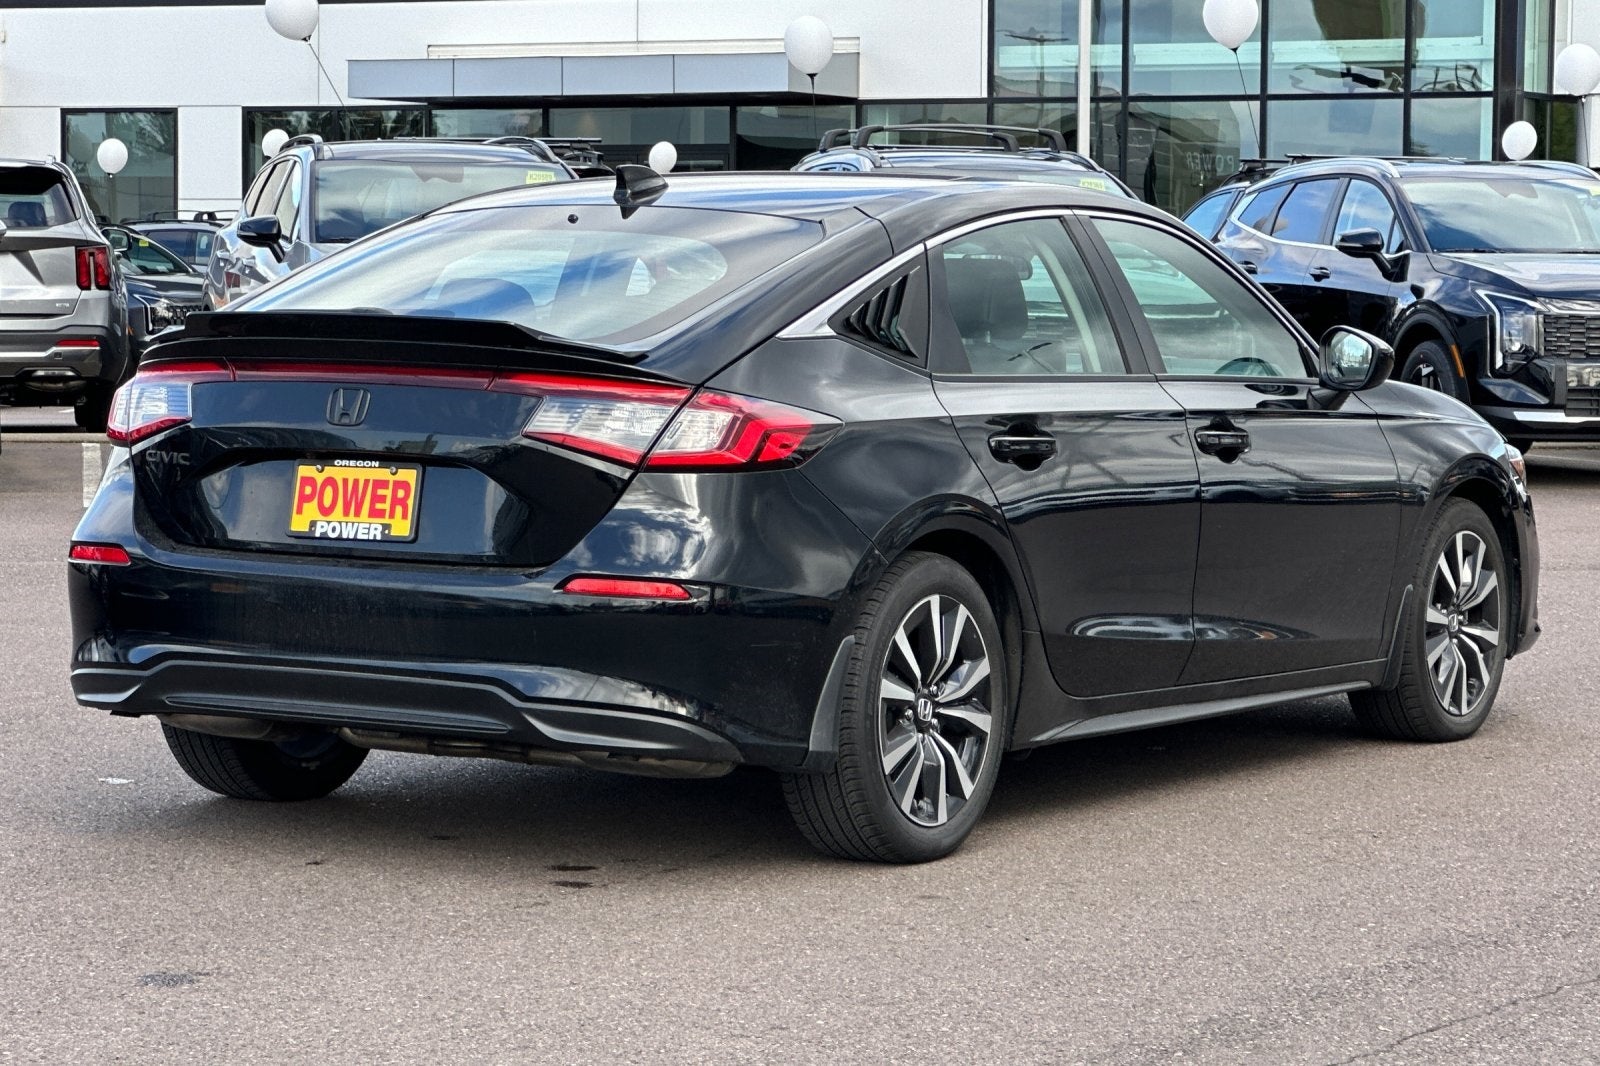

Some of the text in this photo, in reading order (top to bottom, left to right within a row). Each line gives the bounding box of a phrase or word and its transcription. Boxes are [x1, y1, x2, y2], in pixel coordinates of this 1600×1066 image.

[145, 450, 190, 466] CIVIC
[334, 459, 380, 468] OREGON
[296, 476, 411, 520] POWER
[315, 521, 383, 540] POWER
